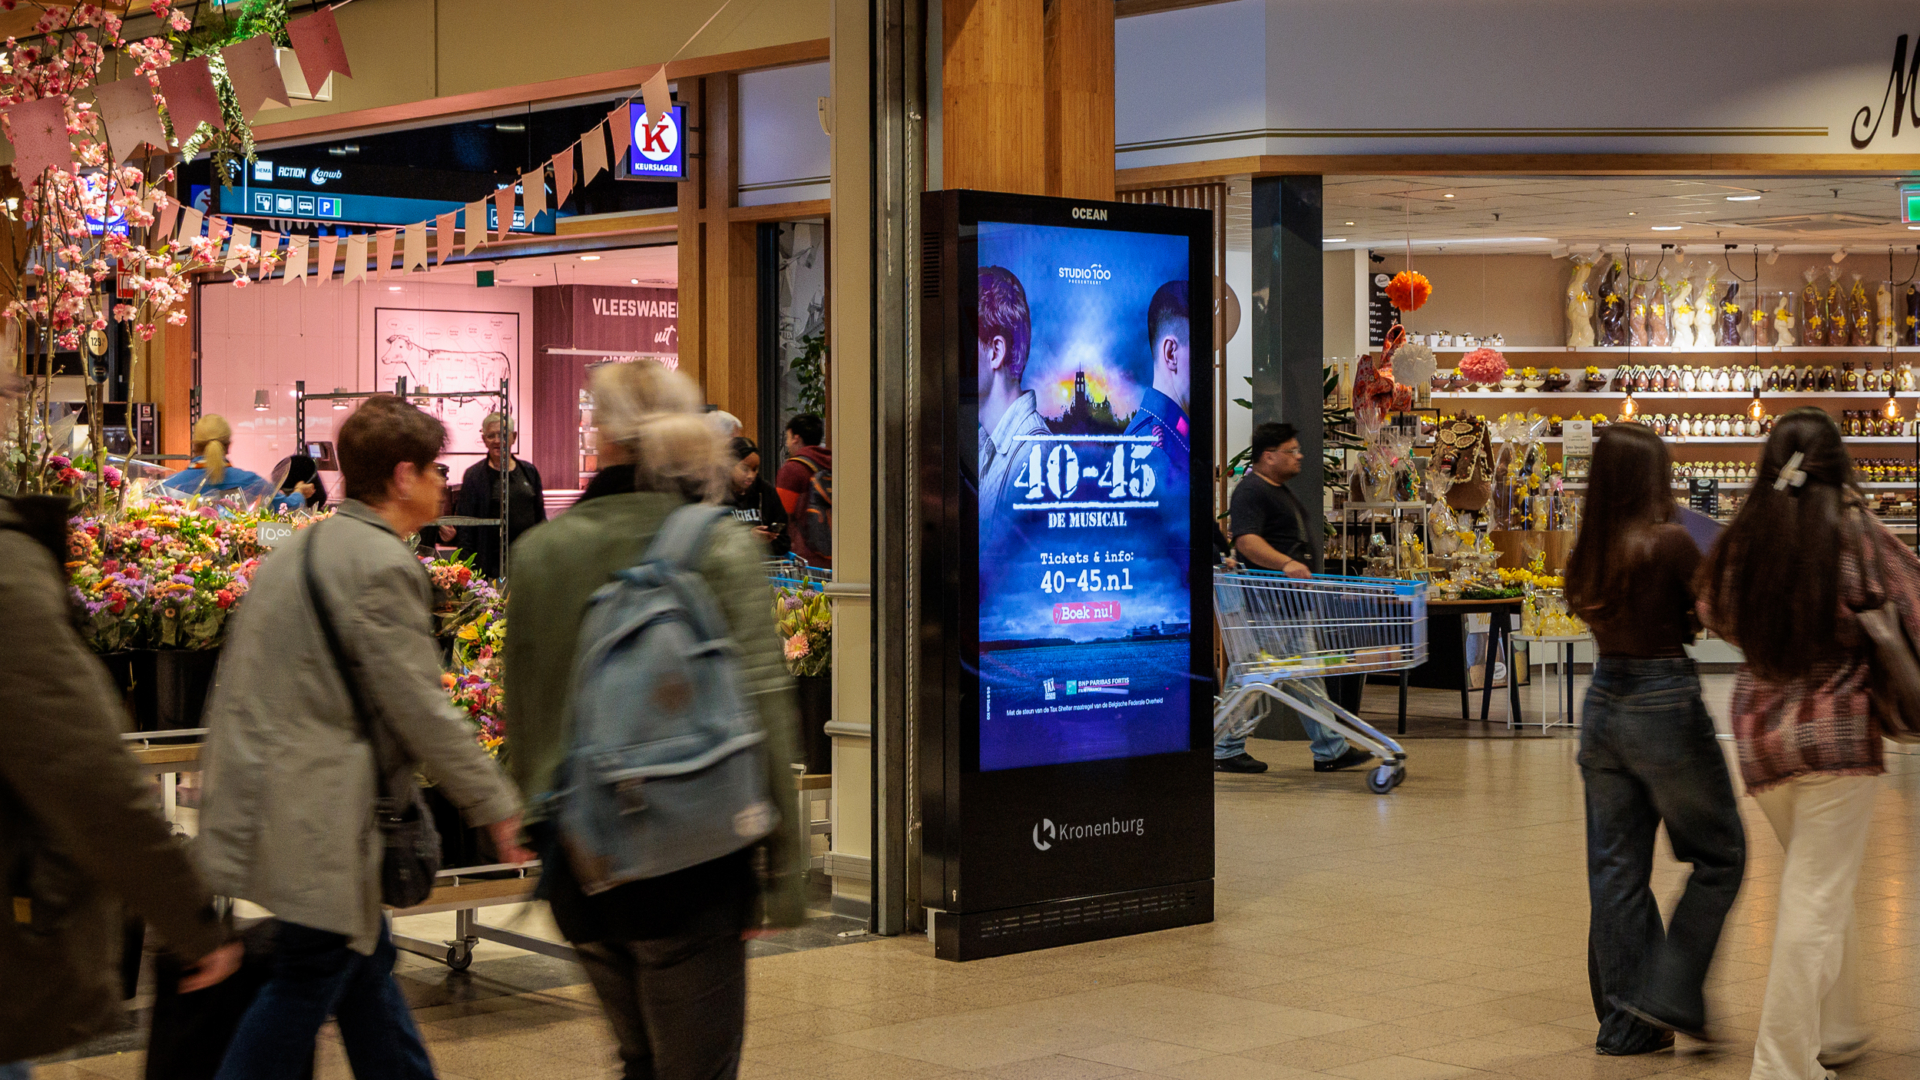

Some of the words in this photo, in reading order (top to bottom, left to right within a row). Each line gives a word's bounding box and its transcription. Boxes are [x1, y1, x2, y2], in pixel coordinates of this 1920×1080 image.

[278, 166, 307, 178] ACTION
[635, 162, 678, 172] KEURSLAGER
[1072, 207, 1108, 221] OCEAN
[1059, 267, 1092, 279] STUDIO
[1093, 269, 1111, 280] 100
[592, 298, 678, 318] VLEESWARE
[654, 325, 677, 345] uit
[1014, 444, 1156, 499] 40-45
[1048, 512, 1066, 528] DE
[1069, 511, 1127, 528] MUSICAL
[1040, 552, 1089, 565] Tickets
[1093, 551, 1100, 563] &
[1104, 551, 1134, 563] info:
[1040, 568, 1134, 593] 40-45.nl
[1061, 605, 1090, 620] Boek
[1094, 604, 1113, 618] nu!
[1044, 681, 1055, 693] TAX
[1090, 678, 1111, 686] PARIBAS
[1073, 703, 1093, 711] maatregel
[1108, 701, 1128, 709] Belgische
[1146, 697, 1164, 705] Overheid
[1060, 817, 1144, 836] Kronenburg
